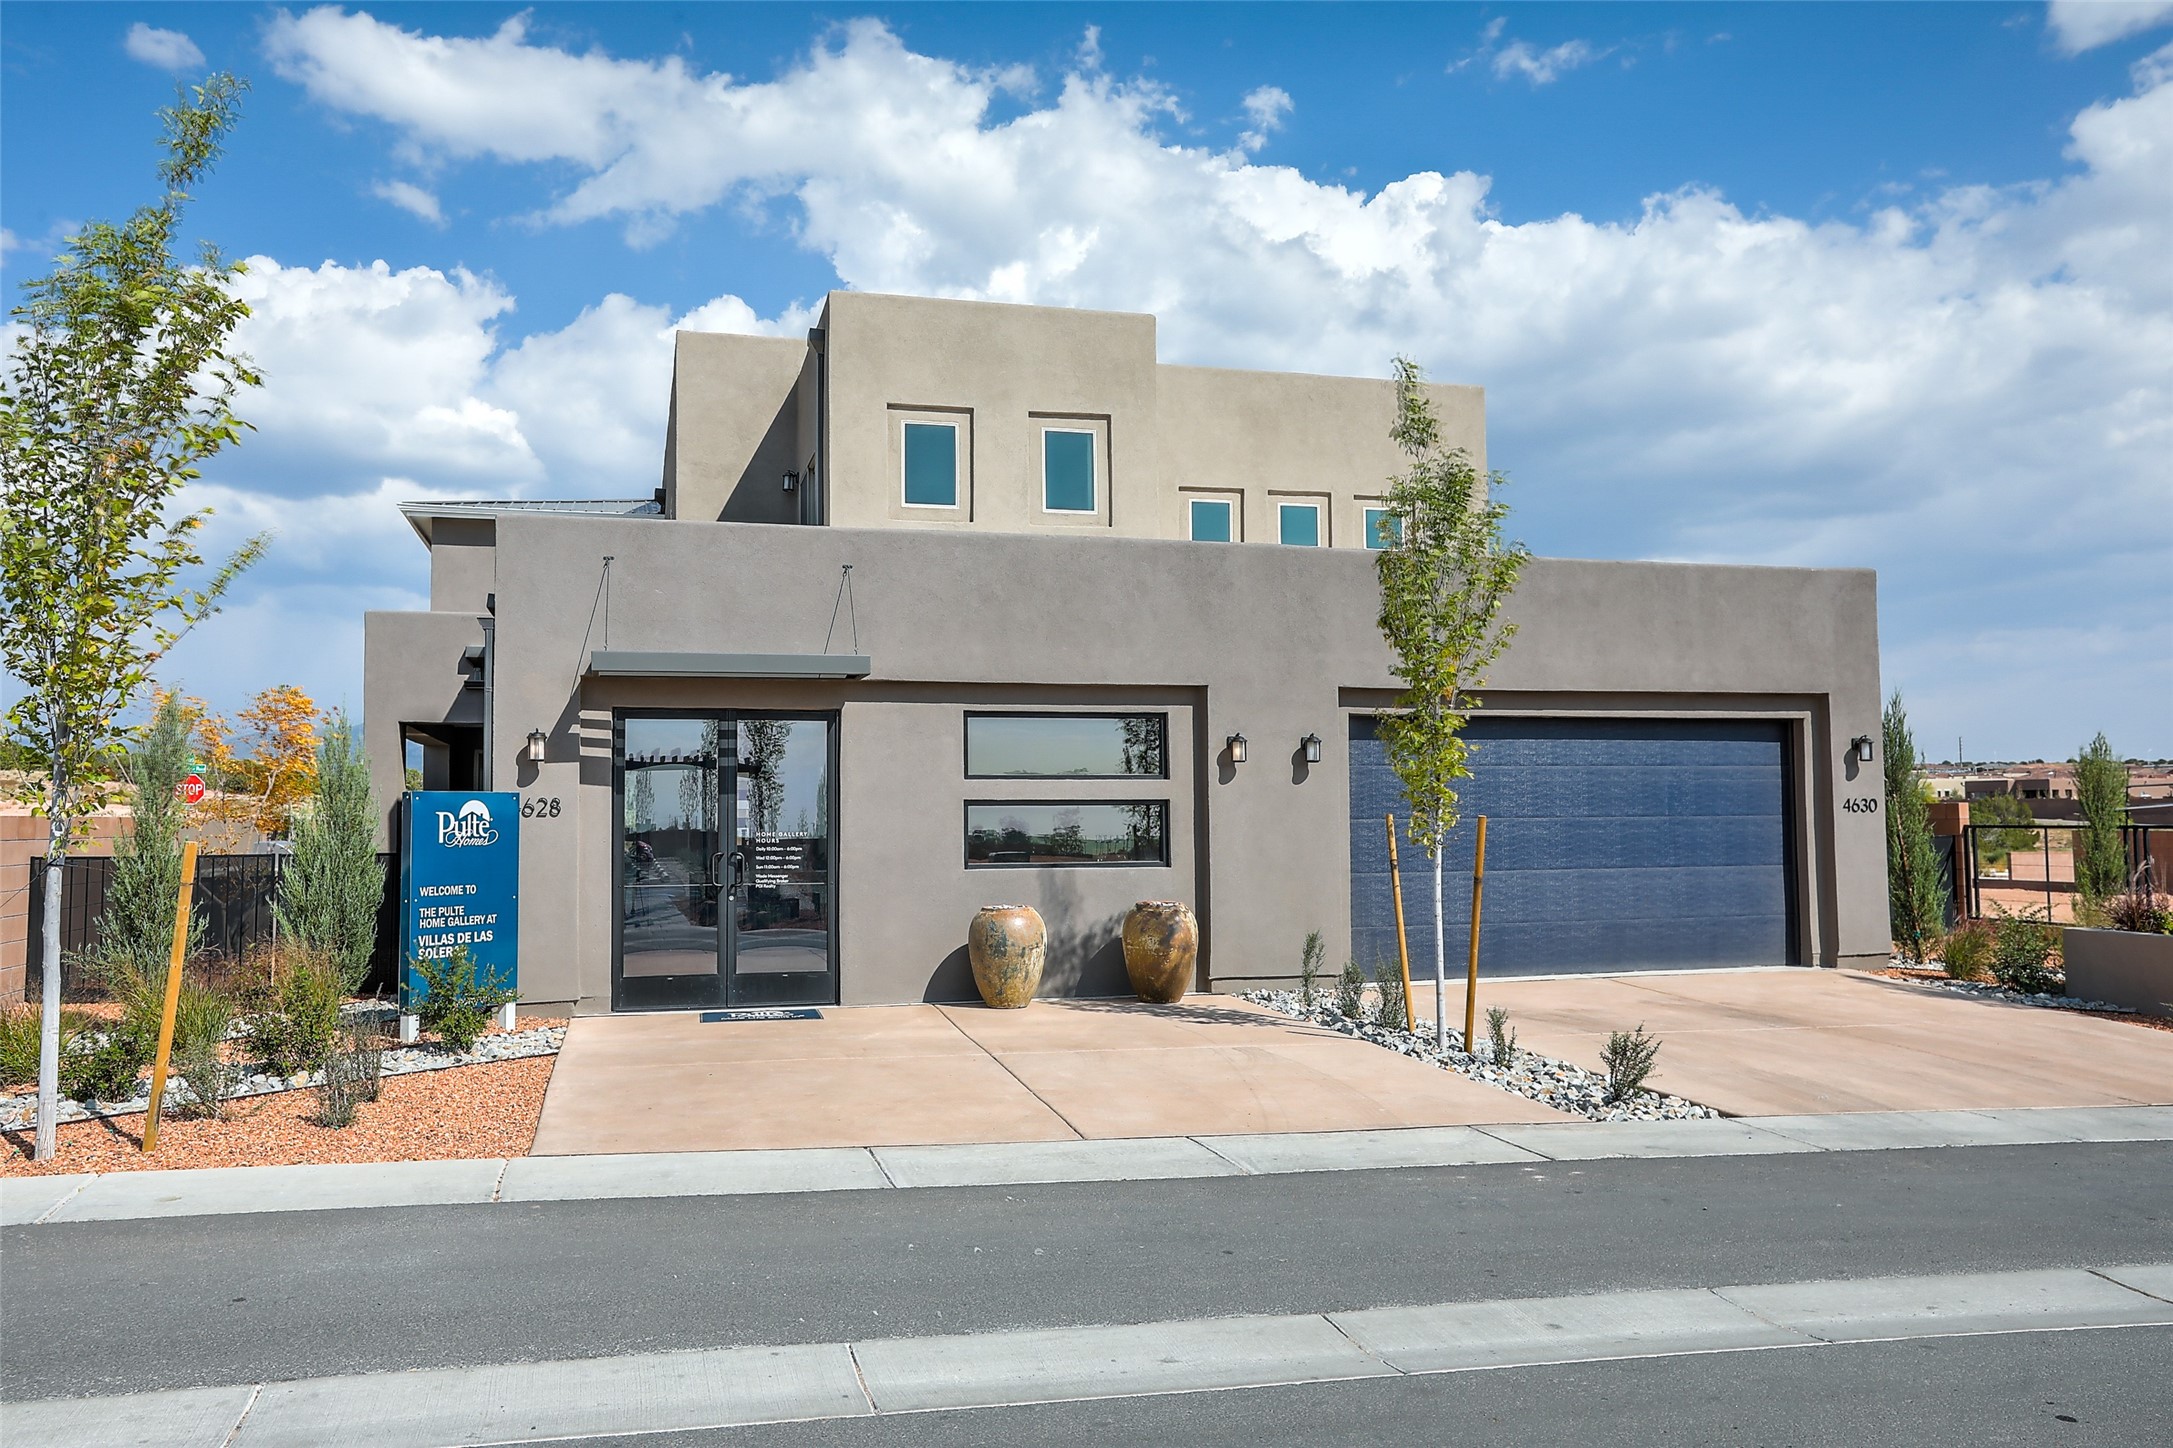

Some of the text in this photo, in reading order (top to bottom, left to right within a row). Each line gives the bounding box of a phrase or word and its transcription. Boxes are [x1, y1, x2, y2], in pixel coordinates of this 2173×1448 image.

[175, 783, 203, 796] STOP
[519, 797, 562, 819] 628
[1842, 797, 1878, 813] 4630
[435, 811, 491, 844] Pulte
[444, 829, 499, 848] Homes
[419, 884, 477, 897] WELCOME TO
[419, 905, 465, 918] THE PULTE
[419, 913, 497, 929] HOME GALLERY AT
[418, 930, 493, 947] VILLAS DE LAS
